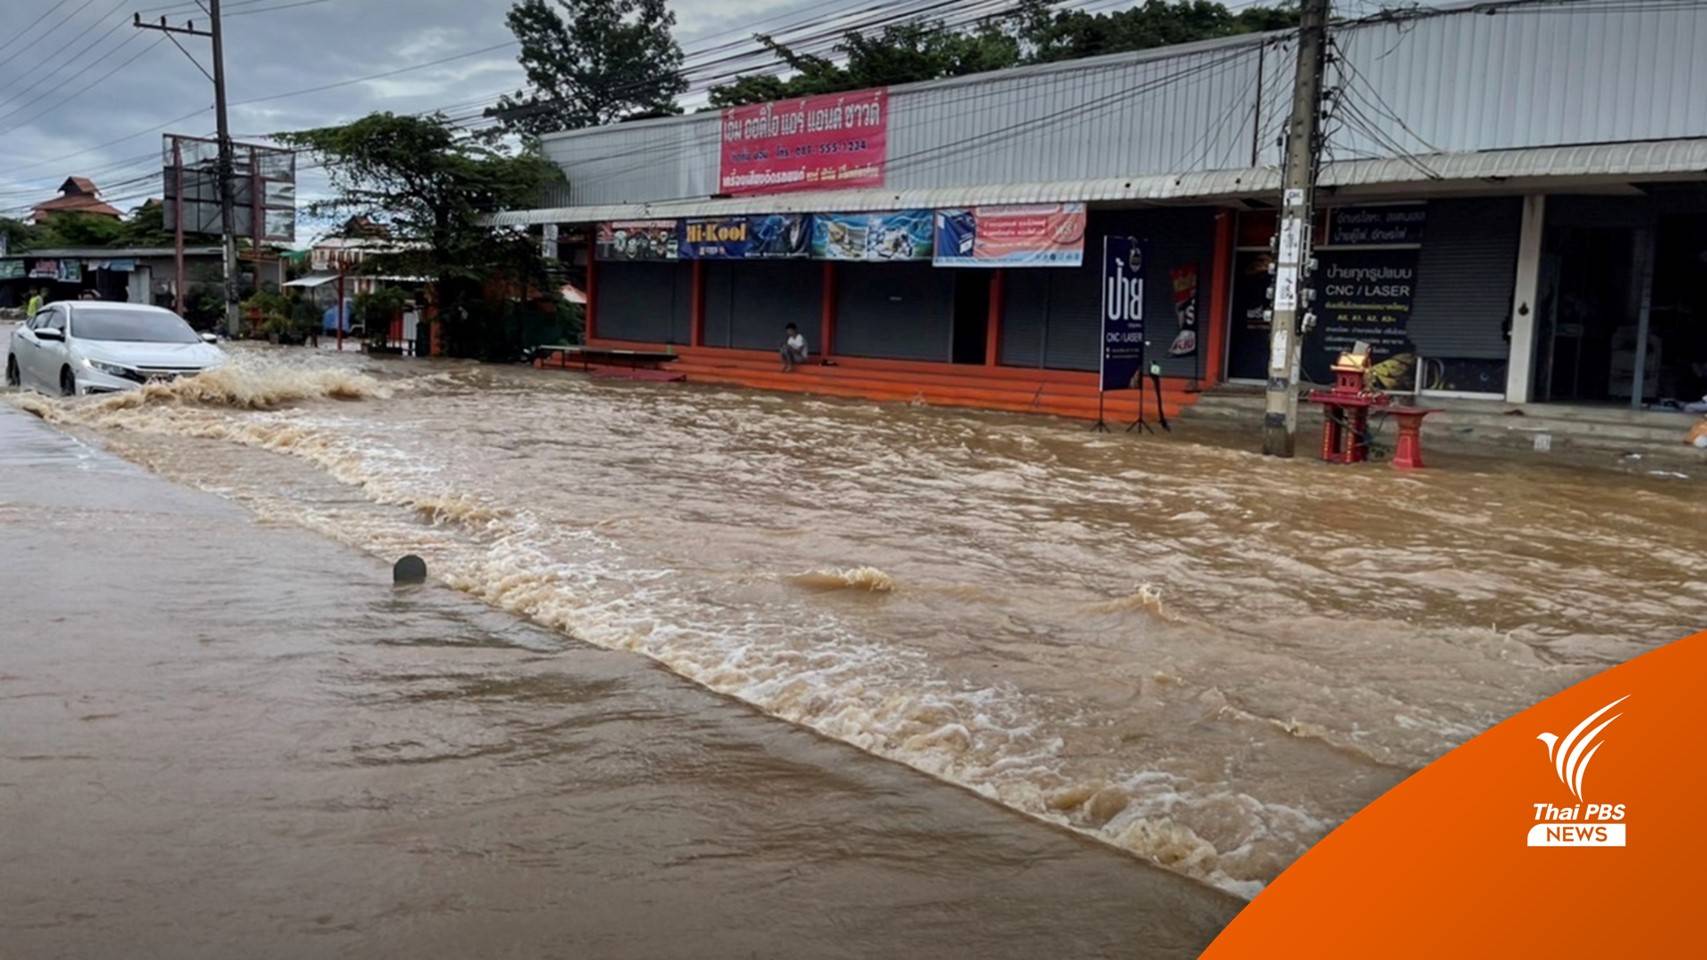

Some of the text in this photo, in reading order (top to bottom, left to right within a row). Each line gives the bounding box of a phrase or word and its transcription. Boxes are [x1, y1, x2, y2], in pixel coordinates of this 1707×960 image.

[781, 100, 806, 135] แอร์
[807, 97, 844, 132] แอนด์
[686, 223, 747, 243] Hi-Kool
[1326, 263, 1413, 282] ป้ายทุกรูปแบบ
[1107, 257, 1143, 321] ป้าย
[1325, 284, 1411, 297] CNC / LASER
[1124, 332, 1143, 343] LASER
